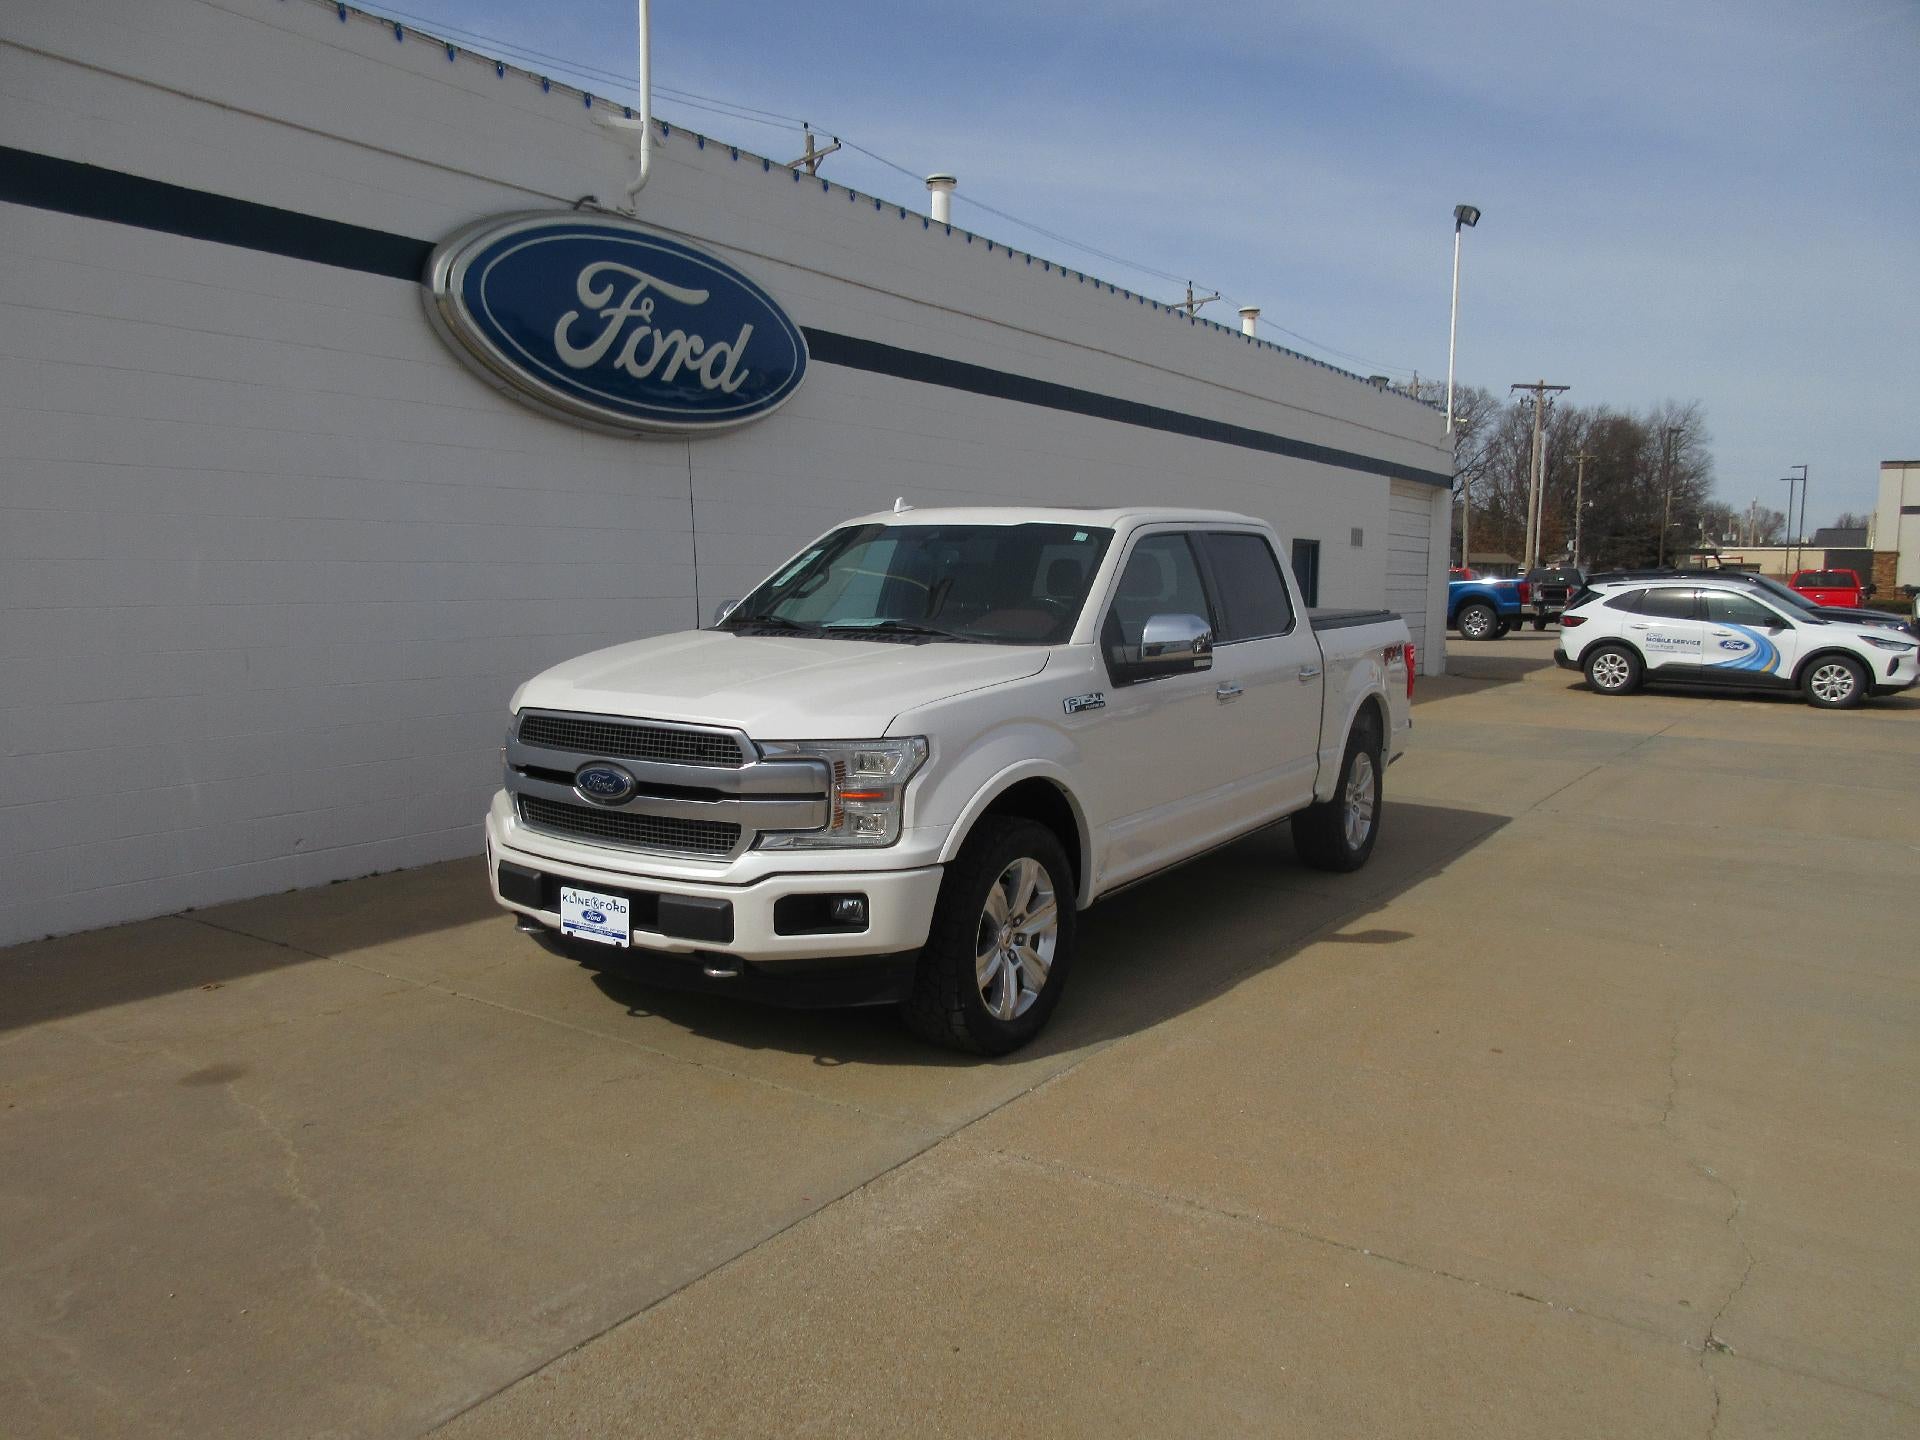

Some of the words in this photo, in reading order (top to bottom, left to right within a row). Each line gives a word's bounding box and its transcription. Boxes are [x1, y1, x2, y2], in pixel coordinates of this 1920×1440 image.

[554, 261, 754, 394] Ford
[1724, 640, 1745, 650] Ford
[587, 773, 616, 793] Ford
[563, 894, 590, 907] KLINE
[600, 901, 627, 914] FORD
[586, 910, 602, 922] Ford
